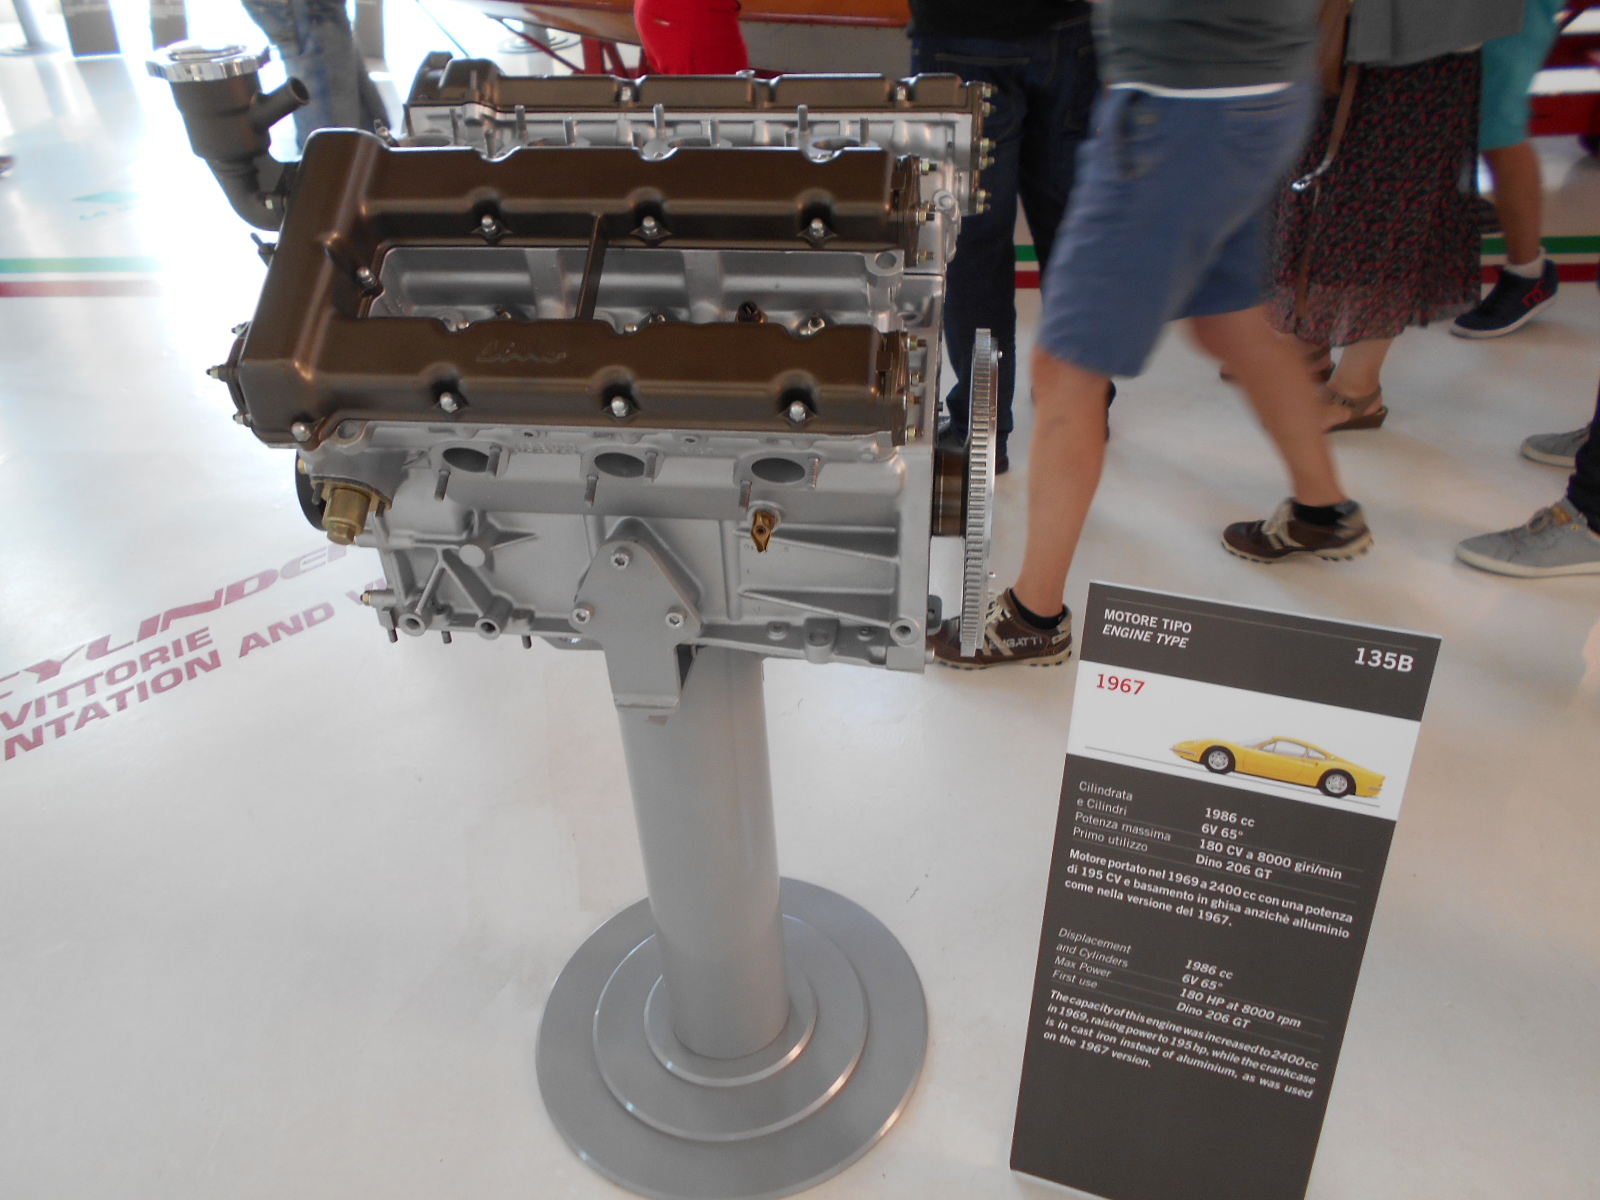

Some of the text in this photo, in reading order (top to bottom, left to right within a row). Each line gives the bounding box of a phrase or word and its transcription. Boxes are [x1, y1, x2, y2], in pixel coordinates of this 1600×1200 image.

[239, 602, 335, 658] AND
[1104, 608, 1192, 633] MOTORE TIPO
[1102, 623, 1189, 648] ENGINE TYPE
[1354, 647, 1414, 672] 135B
[0, 627, 213, 730] VITTORIE
[1096, 673, 1145, 695] 1967
[1078, 780, 1133, 801] Cilindrata
[1076, 798, 1127, 816] e Cilindri
[1205, 807, 1255, 827] 1986 cc
[1072, 825, 1148, 852] Primo utilizzo
[1074, 811, 1171, 841] Potenza massima
[1201, 823, 1243, 839] 6V 65°
[1195, 853, 1272, 879] Dino 206 GT
[1199, 838, 1342, 879] 180 CV a 8000 giri/min
[1069, 848, 1353, 923] Motore portato nel 1969 a 2400 cc con una potenza
[1064, 879, 1232, 926] come nella versione del 1967.
[1066, 863, 1349, 938] di 195 CV e basamento in ghisa anzichè alluminio
[1058, 927, 1131, 954] Displacement
[1054, 955, 1111, 977] Max Power
[1055, 944, 1128, 967] and Cylinders
[1185, 959, 1233, 979] 1986 cc
[1052, 969, 1098, 988] First use
[1181, 973, 1223, 990] 6V 65°
[1176, 1001, 1251, 1029] Dino 206 GT
[1179, 987, 1301, 1028] 180 HP at 8000 rpm
[1050, 989, 1319, 1070] The capacity of this engine was increased to 2400 cc
[1043, 1031, 1151, 1067] on the 1967 version.
[1045, 1016, 1313, 1098] is in cast iron instead of aluminium, as was used
[1047, 1003, 1316, 1084] in 1969, raising power to 195 hp, while the crankcase
